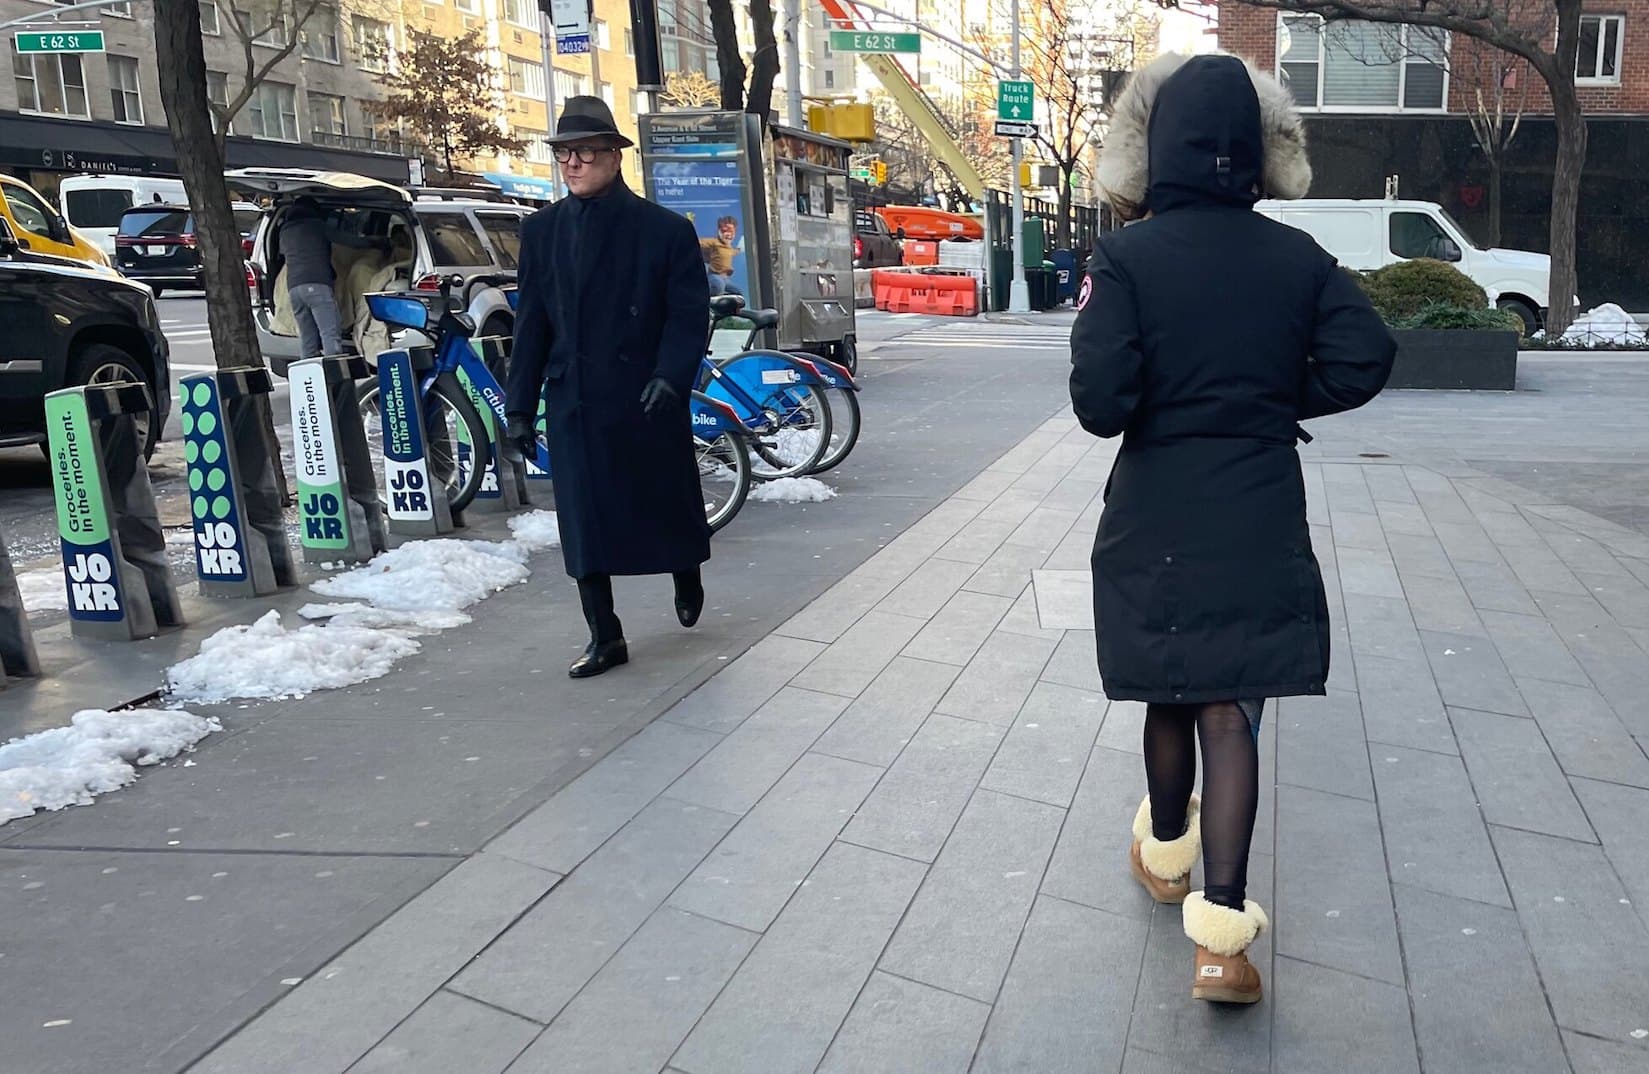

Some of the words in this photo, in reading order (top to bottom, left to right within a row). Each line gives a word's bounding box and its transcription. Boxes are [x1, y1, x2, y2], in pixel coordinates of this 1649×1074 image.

[40, 36, 47, 48] E
[51, 36, 64, 48] 62
[68, 35, 79, 48] St
[854, 35, 861, 48] E
[865, 36, 879, 48] 62
[884, 36, 896, 48] St
[1003, 83, 1029, 93] Truck
[1003, 94, 1029, 104] Route
[672, 177, 688, 185] Year
[715, 177, 734, 186] Tiger
[390, 363, 407, 420] moment.
[304, 376, 320, 438] moment.
[386, 390, 401, 454] Groceries.
[692, 414, 717, 425] bike
[299, 406, 315, 476] Groceries.
[399, 421, 410, 441] the
[62, 410, 85, 485] moment.
[313, 442, 323, 462] the
[402, 442, 412, 454] In
[317, 464, 327, 476] In
[391, 469, 423, 490] JO
[58, 448, 79, 532] Groceries.
[77, 488, 90, 513] the
[304, 493, 339, 516] JO
[393, 491, 428, 512] KR
[83, 518, 94, 532] In
[197, 522, 236, 548] JO
[306, 517, 344, 540] KR
[68, 553, 111, 583] JO
[200, 549, 242, 574] KR
[71, 583, 119, 611] KR
